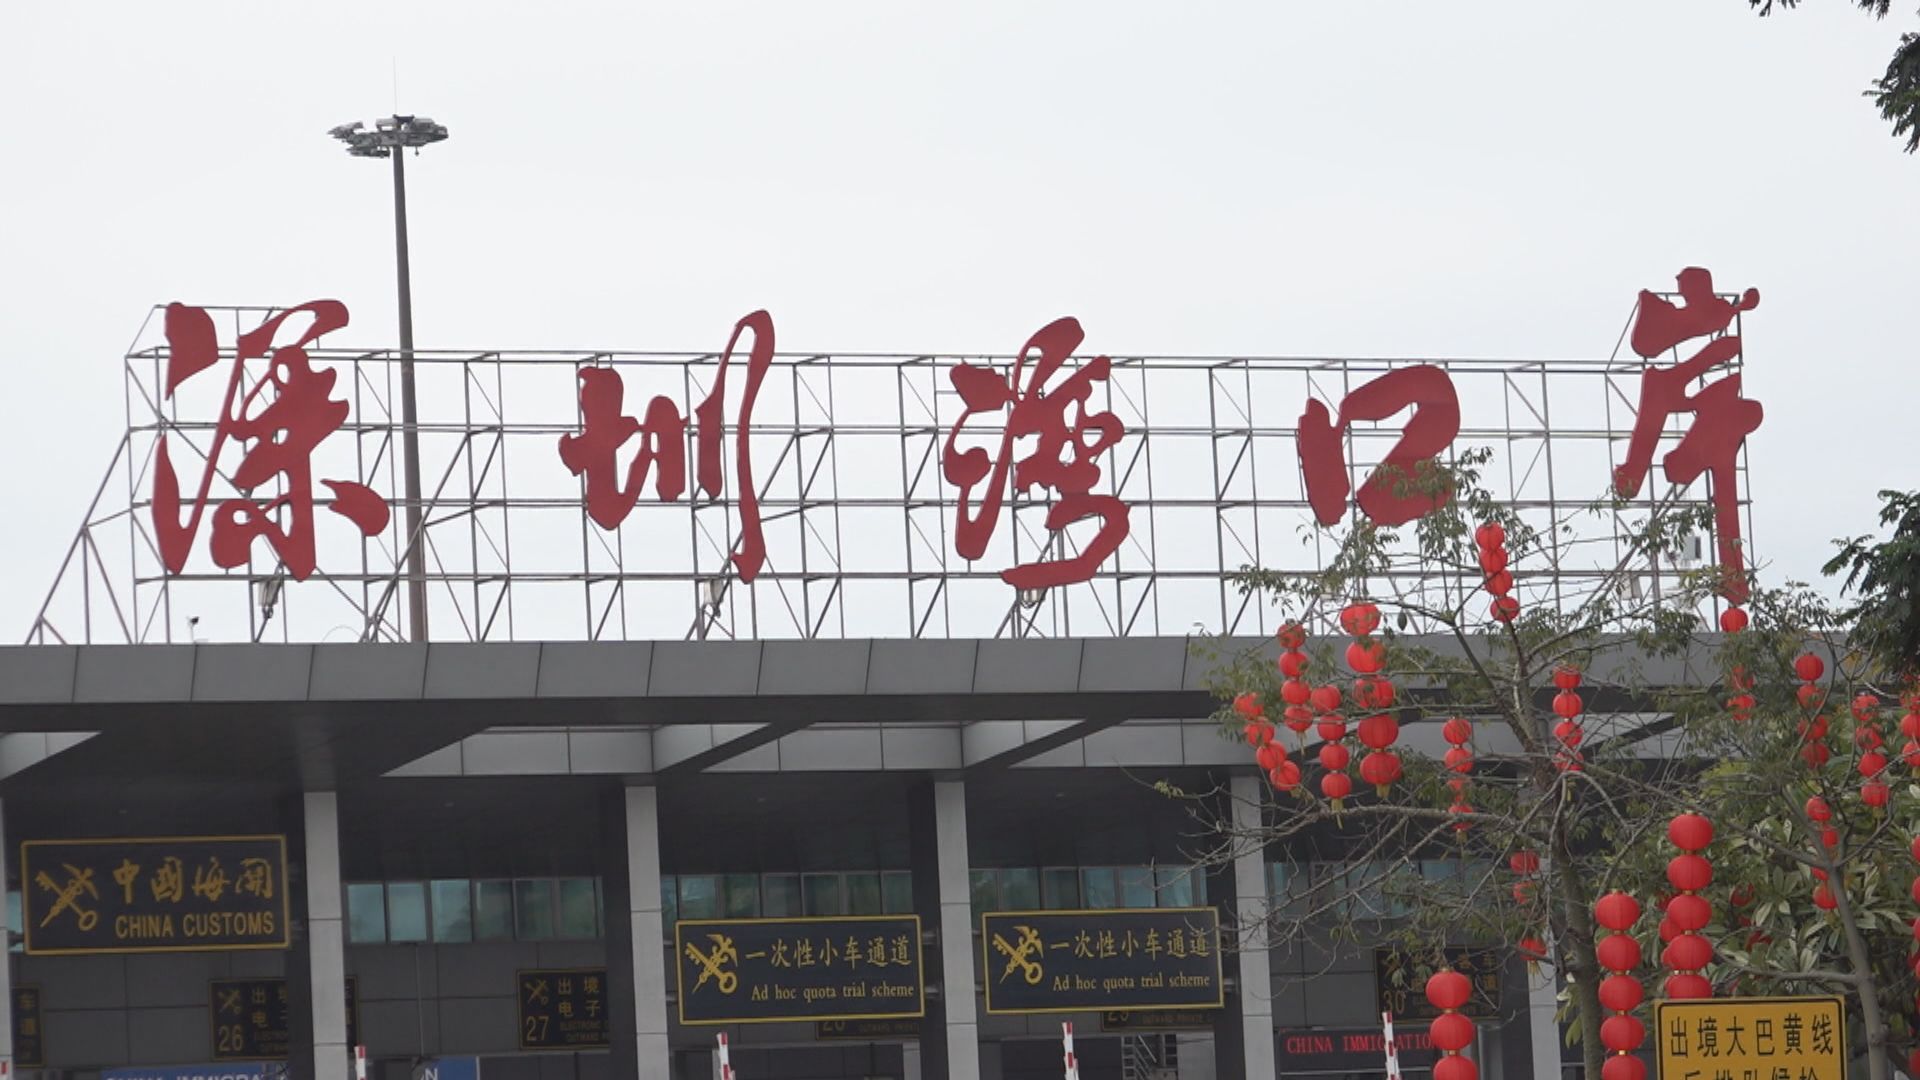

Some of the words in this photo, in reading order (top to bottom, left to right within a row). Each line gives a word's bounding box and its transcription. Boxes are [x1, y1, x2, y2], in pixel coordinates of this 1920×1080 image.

[115, 914, 175, 939] CHINA
[182, 911, 275, 936] CUSTOMS
[745, 935, 912, 969] 一次性小车通道
[1050, 927, 1210, 960] 一次性小车通道
[751, 984, 769, 1000] Ad
[775, 983, 796, 999] hoc
[803, 984, 837, 1003] quota
[842, 982, 866, 998] trial
[871, 981, 914, 997] scheme
[1053, 975, 1070, 991] Ad
[1076, 974, 1097, 990] hoc
[1103, 975, 1135, 993] quota
[1141, 973, 1163, 988] trial
[1168, 971, 1210, 987] scheme
[558, 1000, 601, 1018] 电子
[218, 1024, 244, 1051] 26
[526, 1016, 549, 1041] 27
[1671, 1013, 1834, 1058] 出境大巴黄线
[1286, 1036, 1333, 1053] CHINA
[1343, 1033, 1435, 1052] IMMIGATIO
